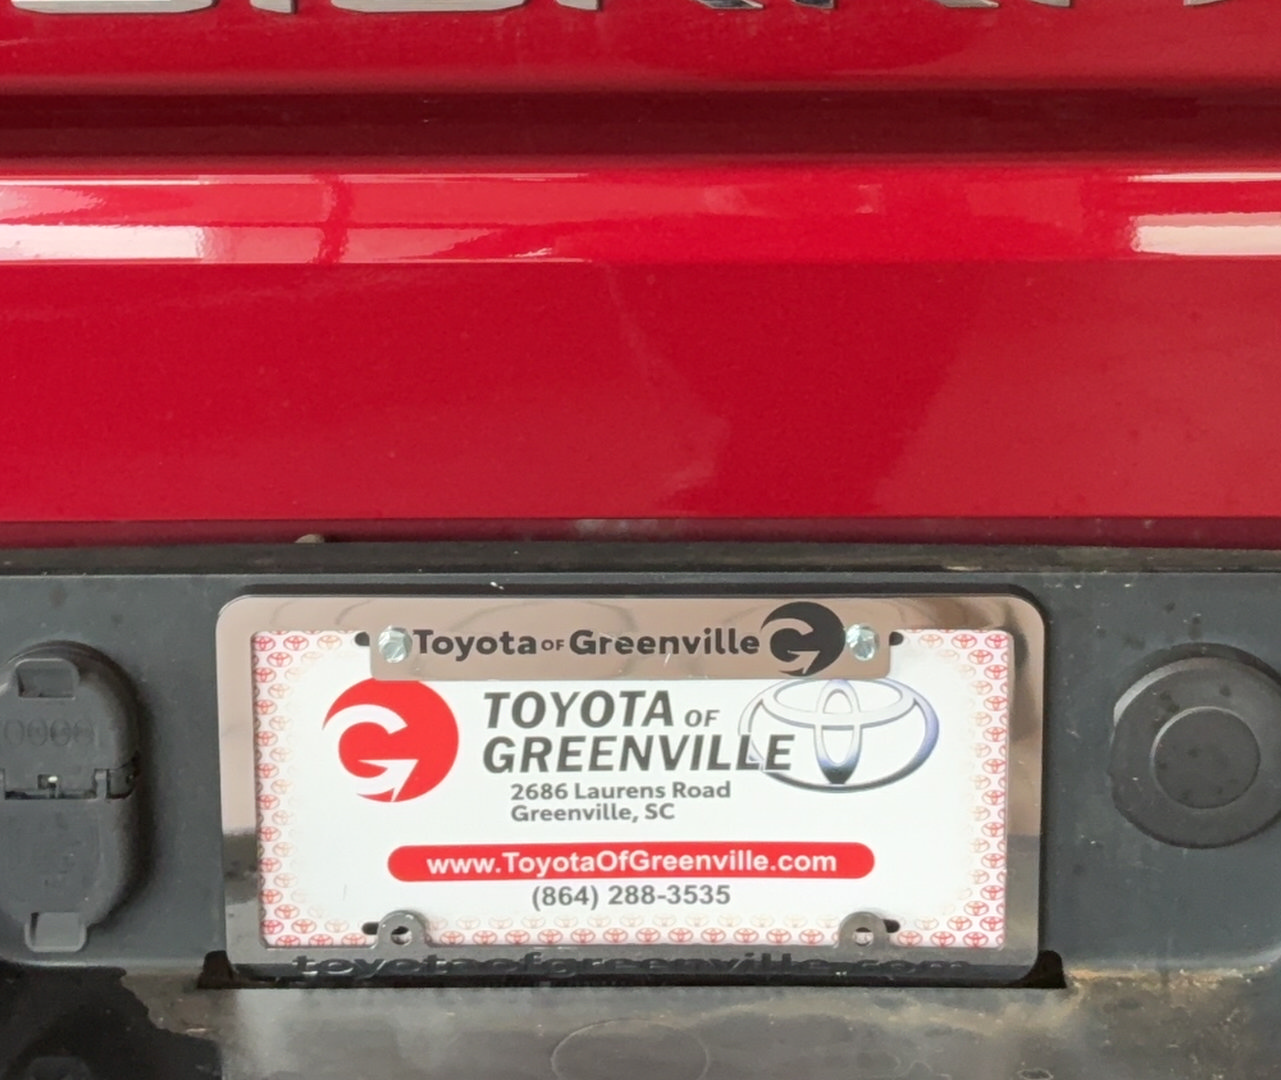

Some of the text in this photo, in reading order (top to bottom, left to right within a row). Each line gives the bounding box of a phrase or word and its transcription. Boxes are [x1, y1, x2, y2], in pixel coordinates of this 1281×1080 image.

[412, 627, 537, 662] Toyota
[540, 639, 565, 652] OF
[570, 627, 761, 656] Greenville
[483, 689, 721, 729] TOYOTA OF
[482, 734, 796, 774] GREENVILLE
[510, 780, 732, 801] 2686 Laurens Road
[510, 803, 676, 824] Greenville, SC
[426, 850, 838, 878] www.ToyotaOfGreenville.com
[531, 883, 732, 911] (864) 288-3535
